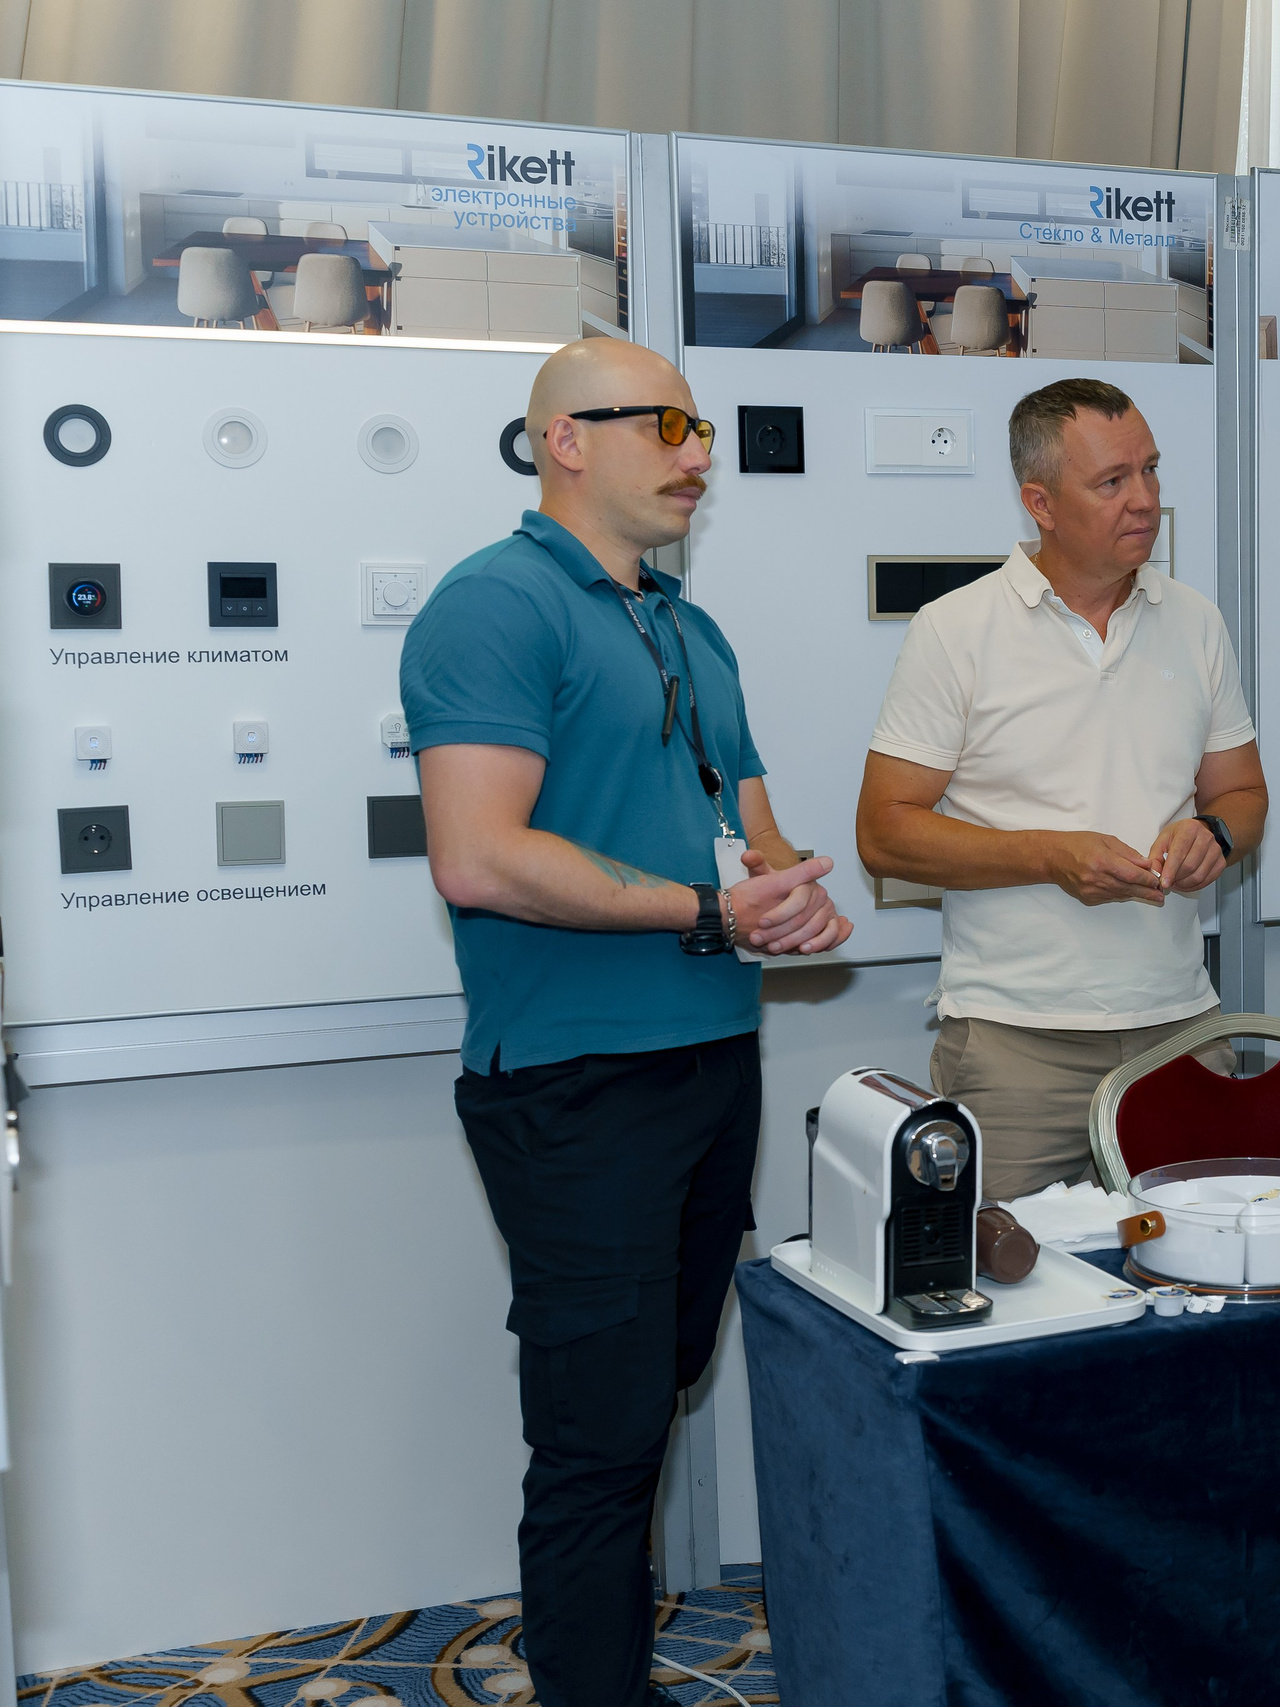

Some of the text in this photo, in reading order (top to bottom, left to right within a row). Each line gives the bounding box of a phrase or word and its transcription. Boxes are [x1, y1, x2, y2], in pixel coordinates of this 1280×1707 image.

[466, 143, 576, 186] Rikett
[431, 187, 577, 211] электронные
[1089, 185, 1176, 223] Rikett
[453, 210, 577, 232] устройства
[1019, 222, 1177, 248] Стекло & Металл
[50, 648, 289, 669] Управление климатом
[60, 882, 327, 912] Управление освещением
